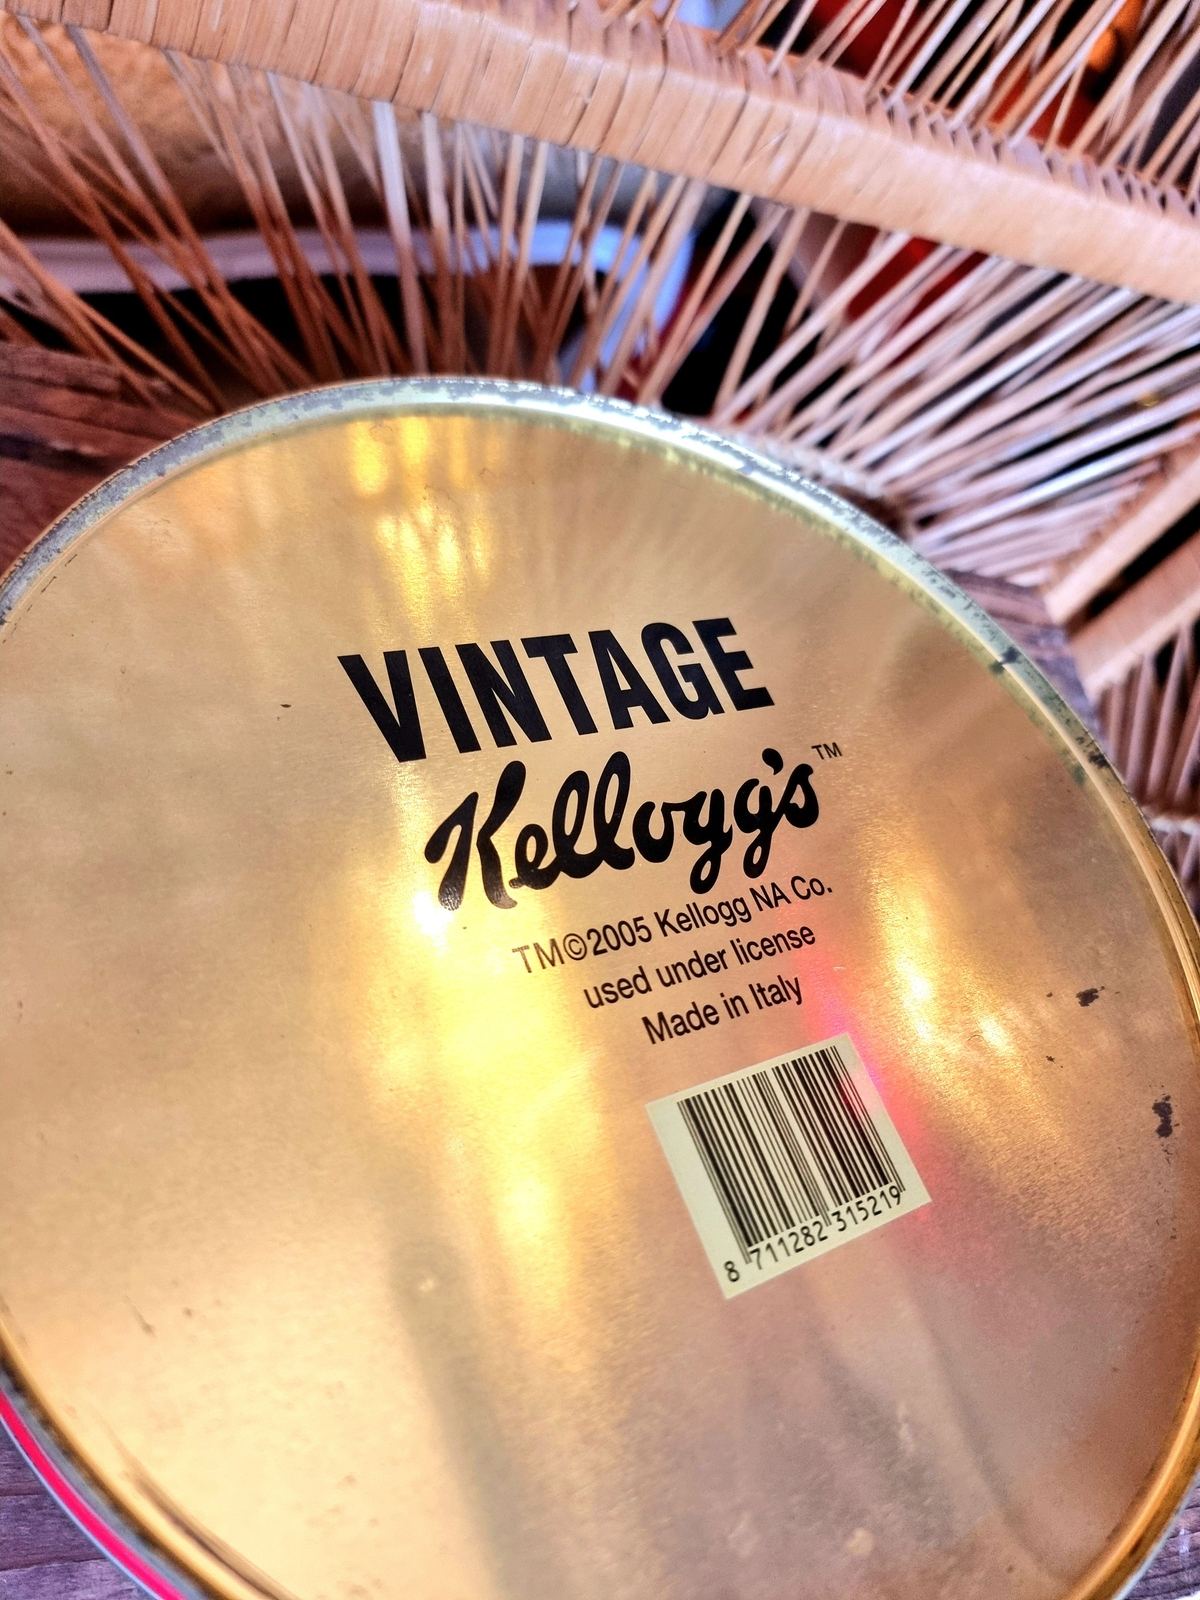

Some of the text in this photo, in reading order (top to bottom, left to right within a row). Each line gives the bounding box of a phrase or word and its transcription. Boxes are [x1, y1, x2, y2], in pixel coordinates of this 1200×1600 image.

[337, 617, 775, 763] VINTAGE
[424, 747, 820, 912] Kellogg's
[654, 896, 751, 937] Kellogg
[749, 882, 791, 912] NA
[790, 875, 833, 901] Co.
[583, 926, 816, 1008] used under license
[642, 974, 804, 1045] Made in Italy
[724, 1185, 902, 1282] 8 711282 315219
